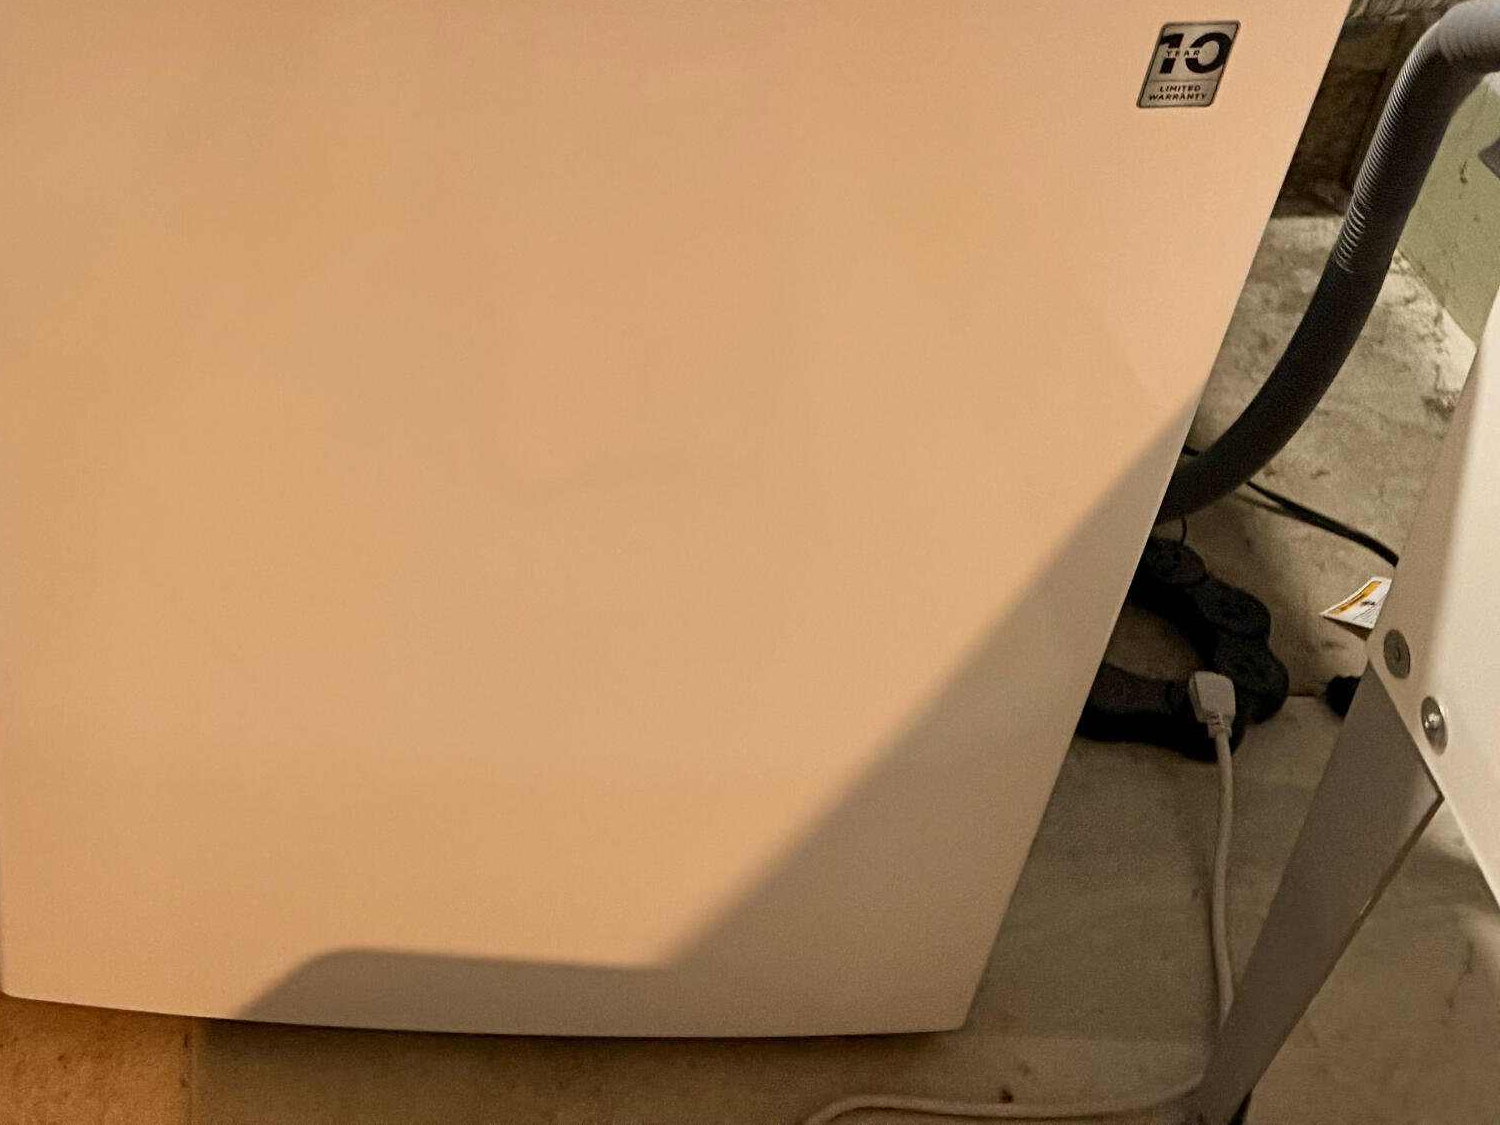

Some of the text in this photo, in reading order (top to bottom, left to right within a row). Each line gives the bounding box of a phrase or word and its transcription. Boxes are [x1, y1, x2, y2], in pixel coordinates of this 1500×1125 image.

[1158, 31, 1233, 74] 10
[1159, 84, 1202, 93] LIMITED
[1149, 93, 1208, 101] WARRANTY
